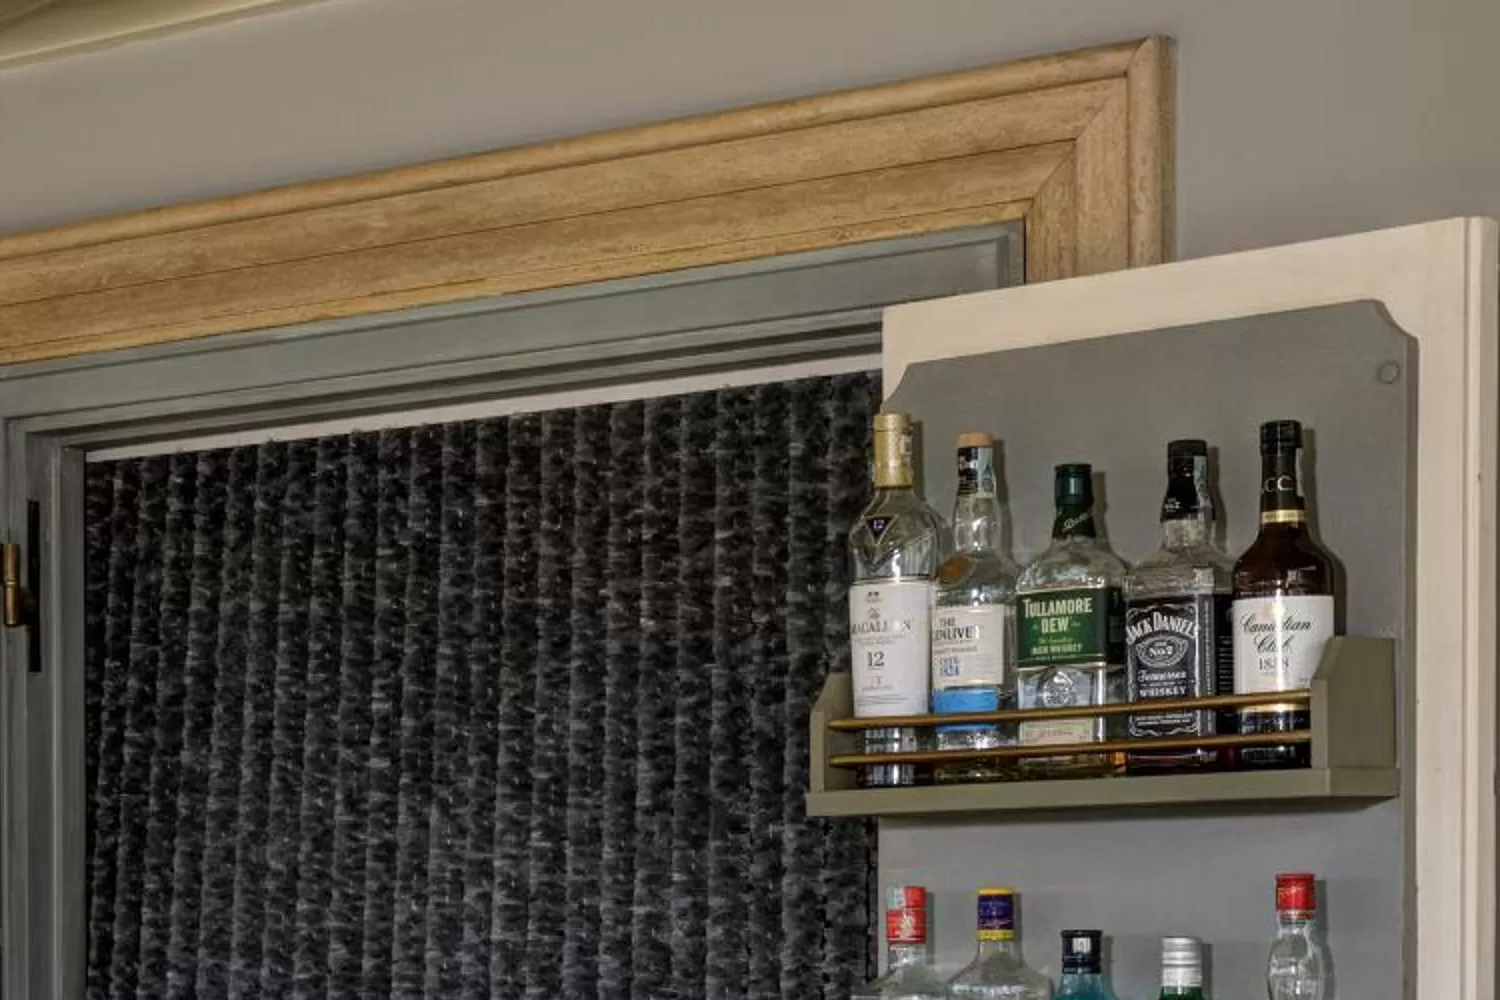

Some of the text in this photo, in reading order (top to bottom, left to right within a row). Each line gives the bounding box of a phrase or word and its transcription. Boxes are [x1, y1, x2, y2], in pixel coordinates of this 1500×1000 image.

[1023, 598, 1093, 620] TULLAMORE
[1041, 616, 1070, 633] DEW
[1125, 617, 1153, 645] JACK
[867, 651, 885, 668] 12
[1139, 685, 1187, 697] WHISKEY
